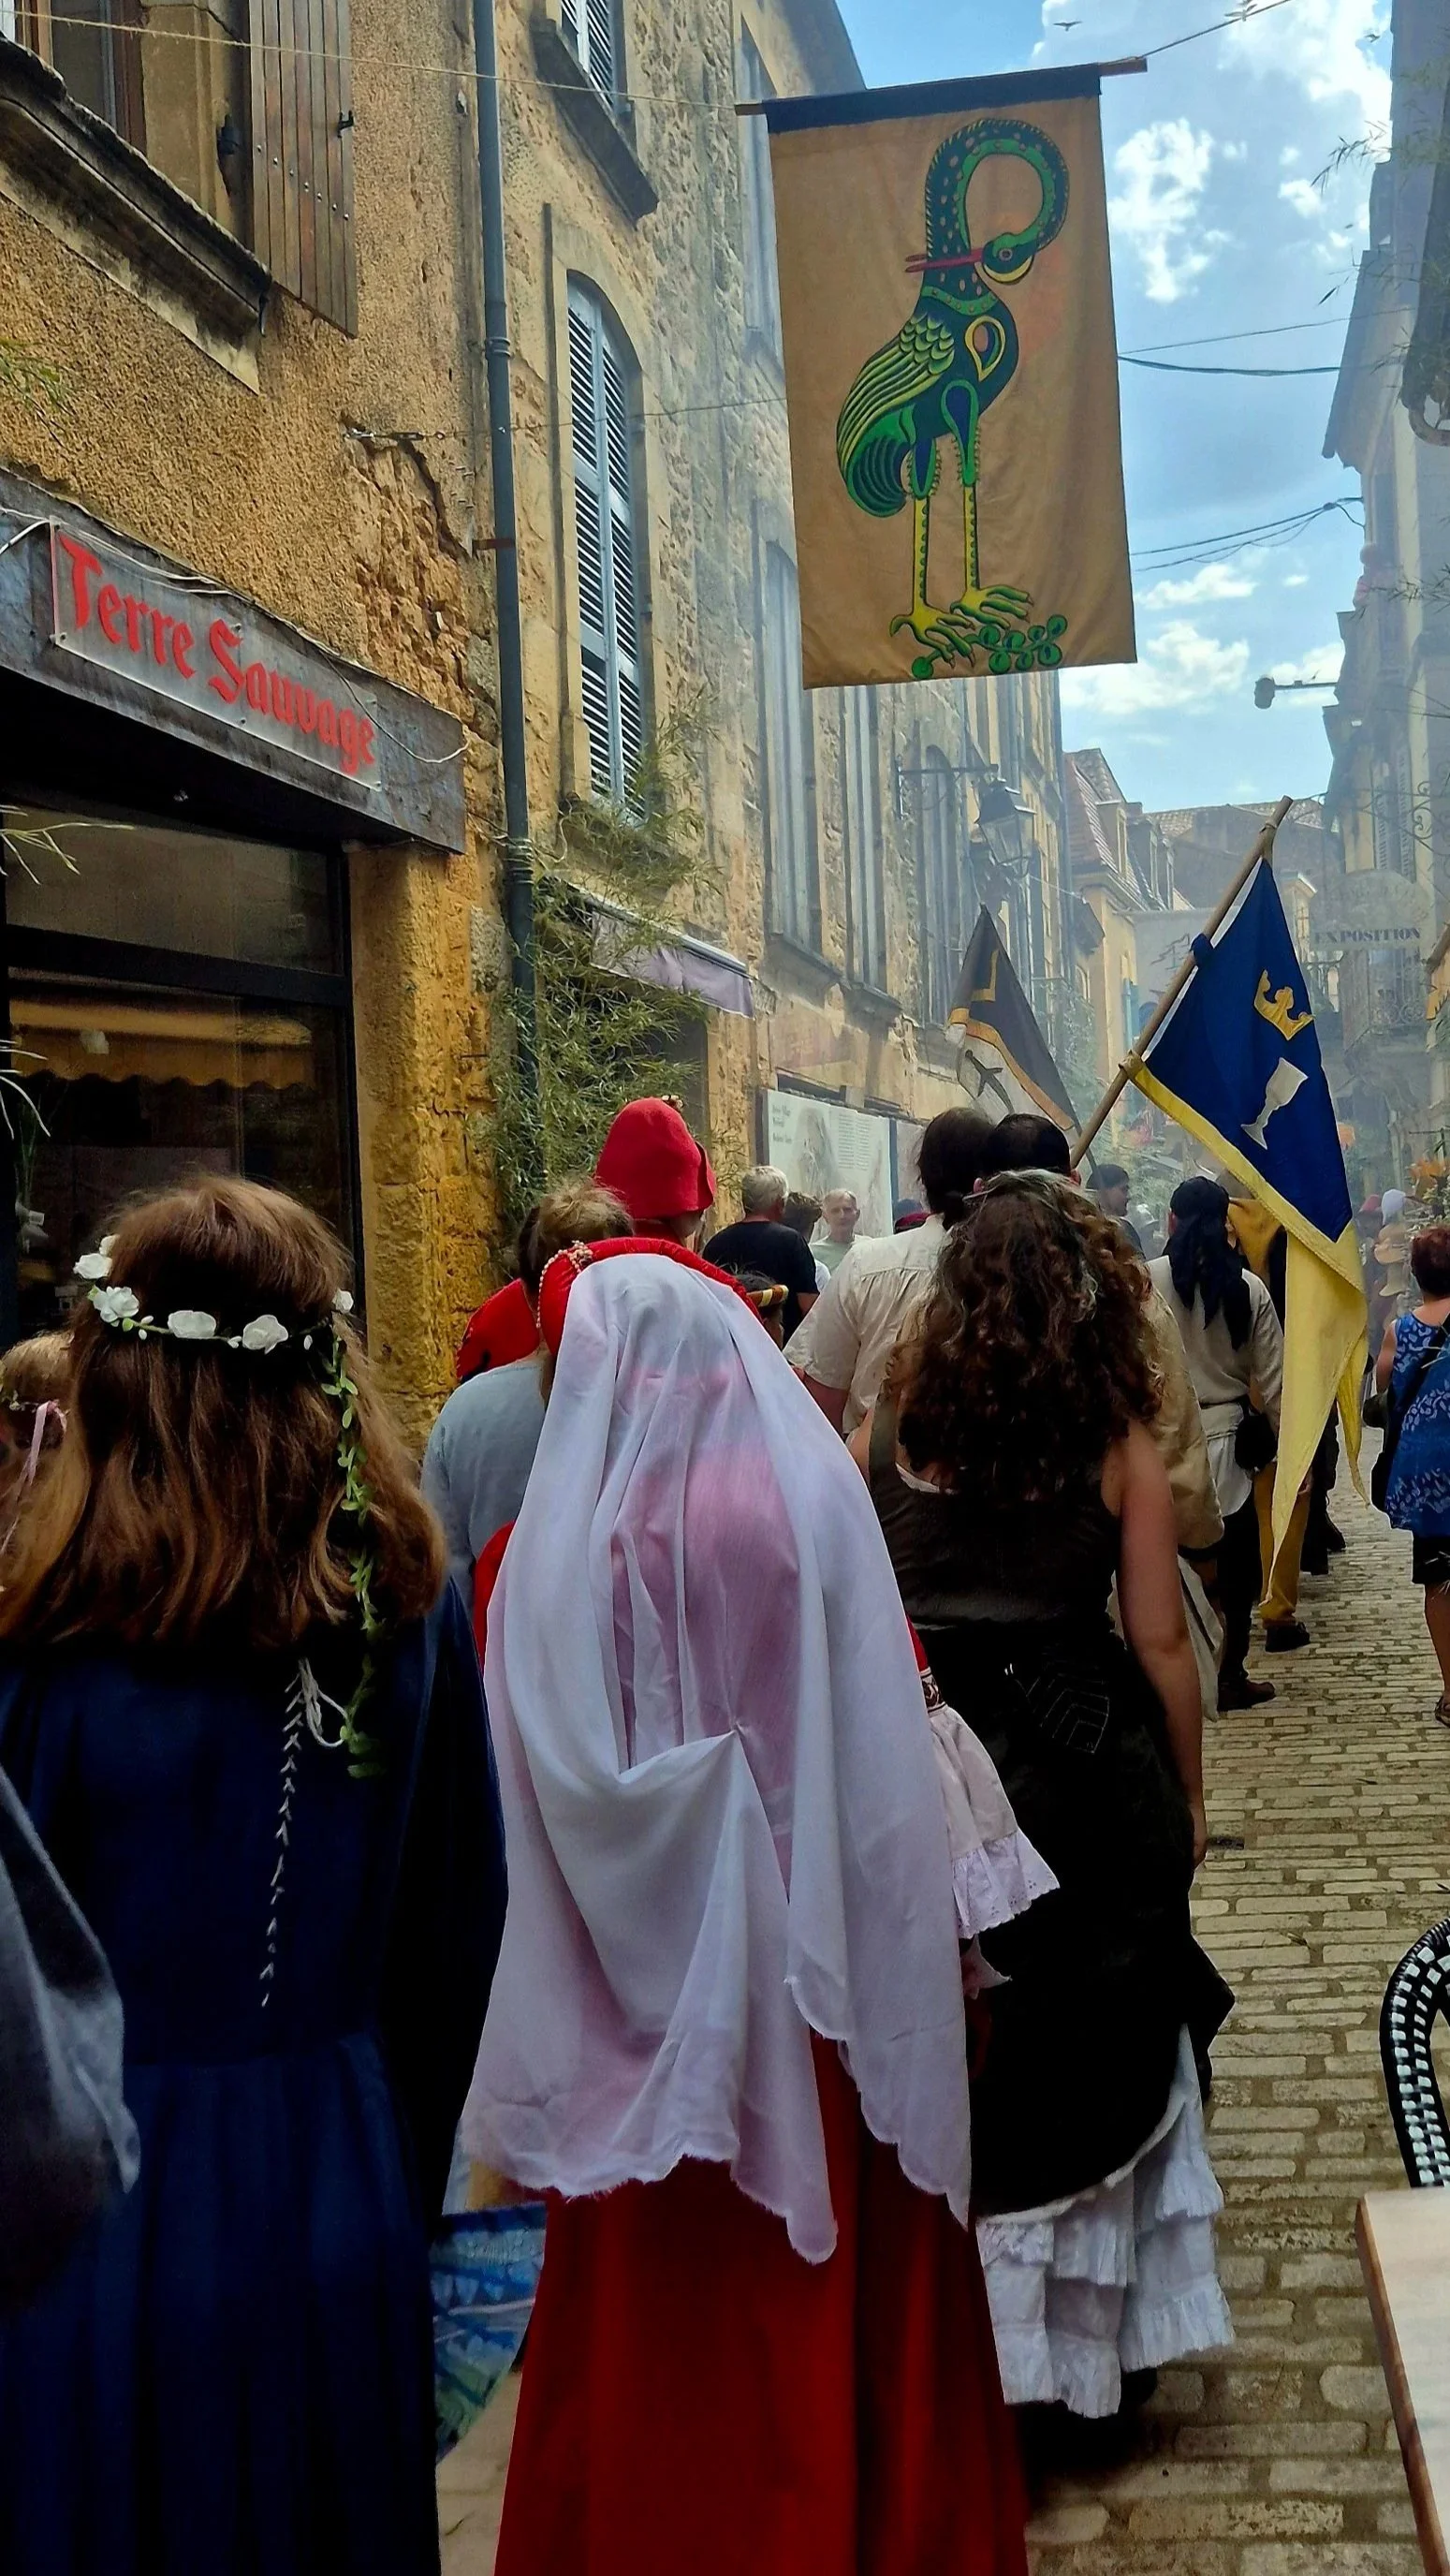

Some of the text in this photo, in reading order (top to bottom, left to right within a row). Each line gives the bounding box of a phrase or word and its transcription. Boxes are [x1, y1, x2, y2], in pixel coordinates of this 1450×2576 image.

[60, 536, 375, 773] Terre Sauvage
[1314, 927, 1421, 944] EXPOSITION
